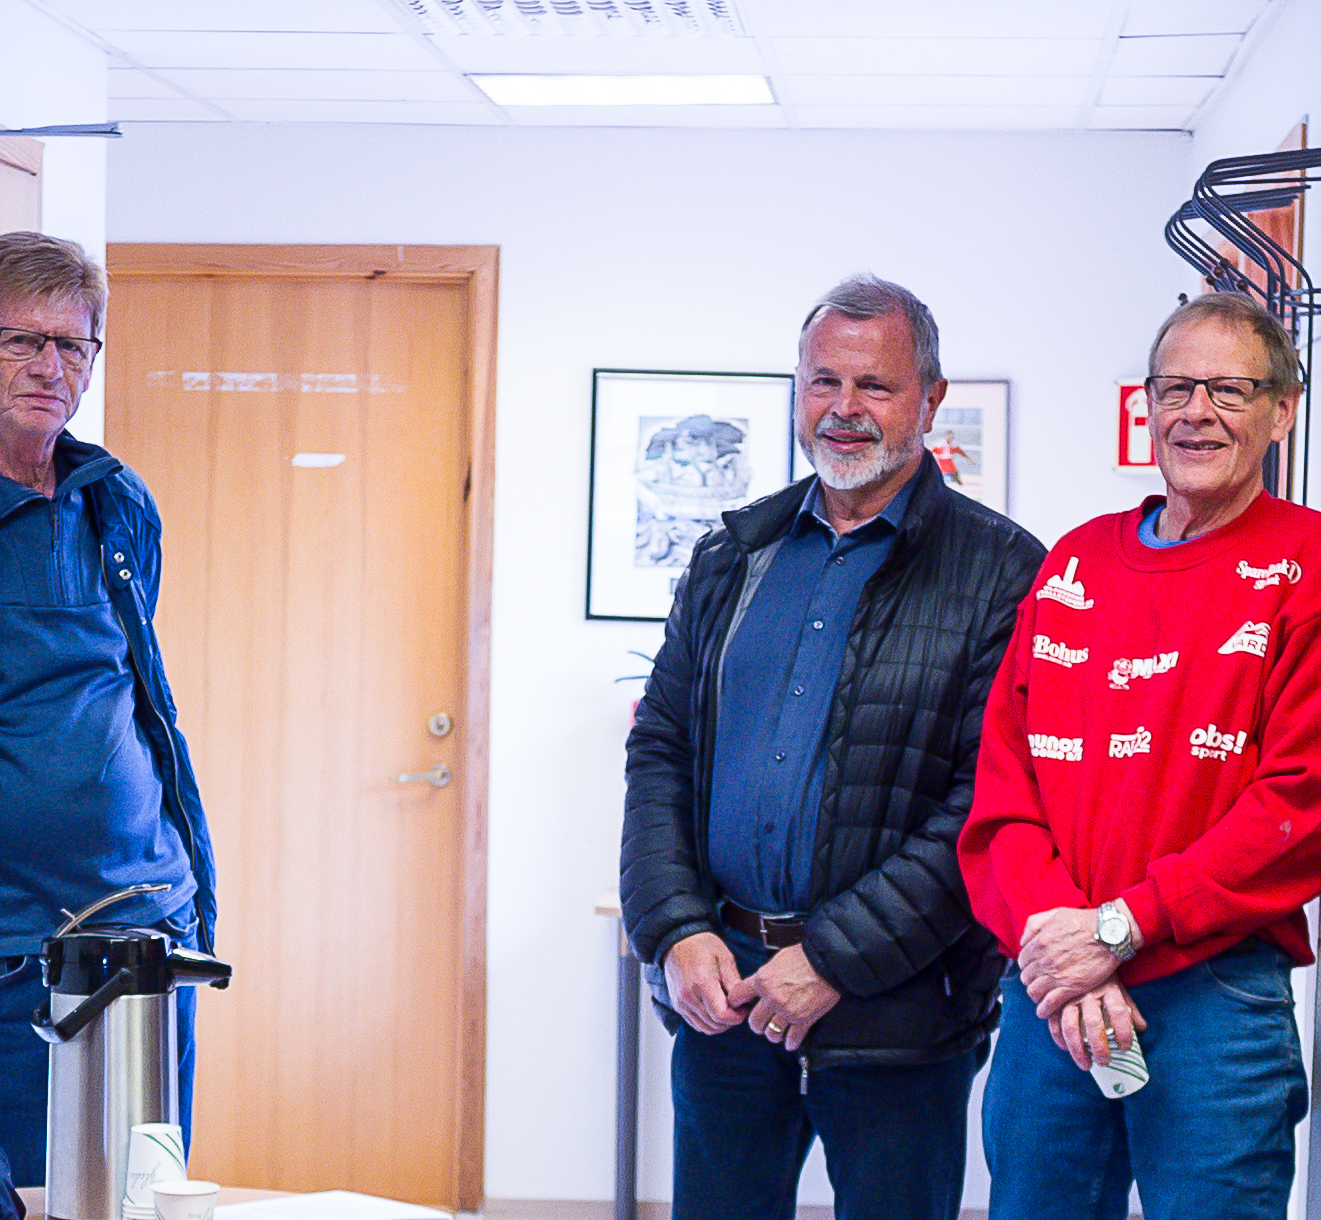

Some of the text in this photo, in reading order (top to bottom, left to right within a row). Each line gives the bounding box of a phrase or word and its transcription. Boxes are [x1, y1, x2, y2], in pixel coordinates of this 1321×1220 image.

[1033, 635, 1089, 664] Bohus
[1189, 723, 1247, 755] obs!
[1191, 746, 1228, 761] sport
